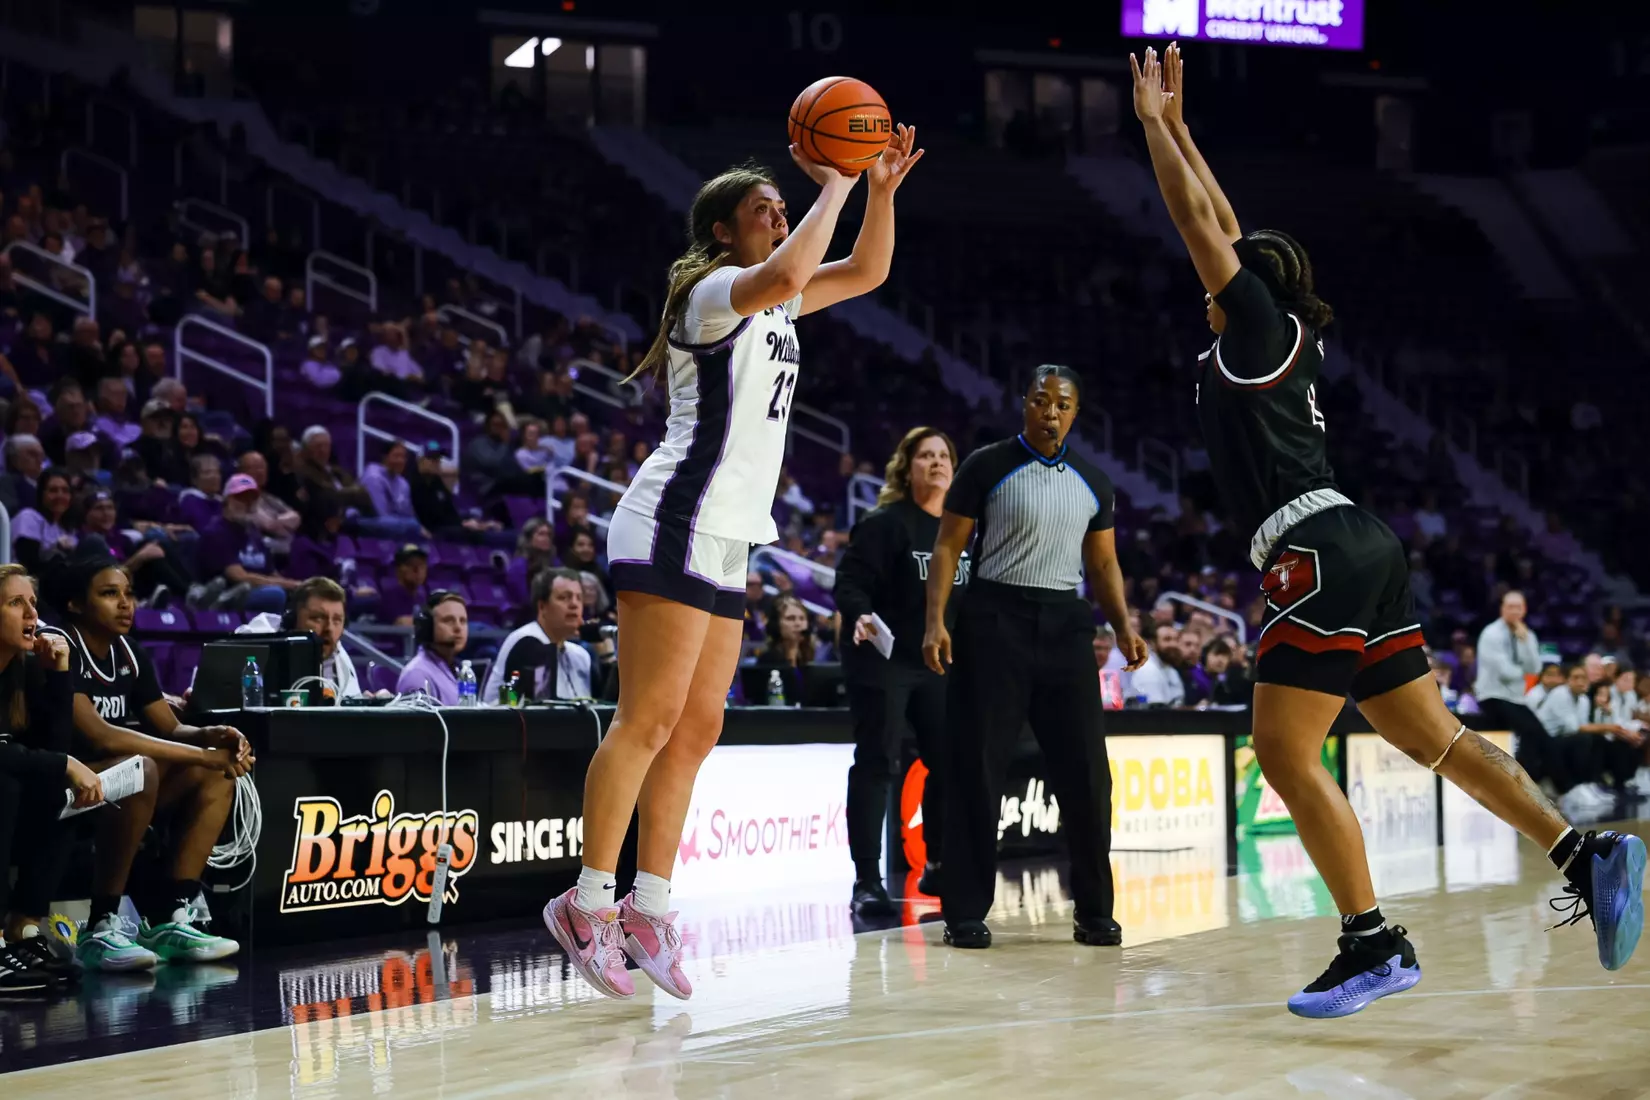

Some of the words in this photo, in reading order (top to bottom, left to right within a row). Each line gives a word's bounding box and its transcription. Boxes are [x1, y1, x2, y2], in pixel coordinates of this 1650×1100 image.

[848, 118, 890, 133] ELITE
[288, 792, 477, 898] Briggs
[490, 818, 565, 864] SINCE
[707, 808, 821, 860] SMOOTHIE
[286, 877, 381, 904] AUTO.COM
